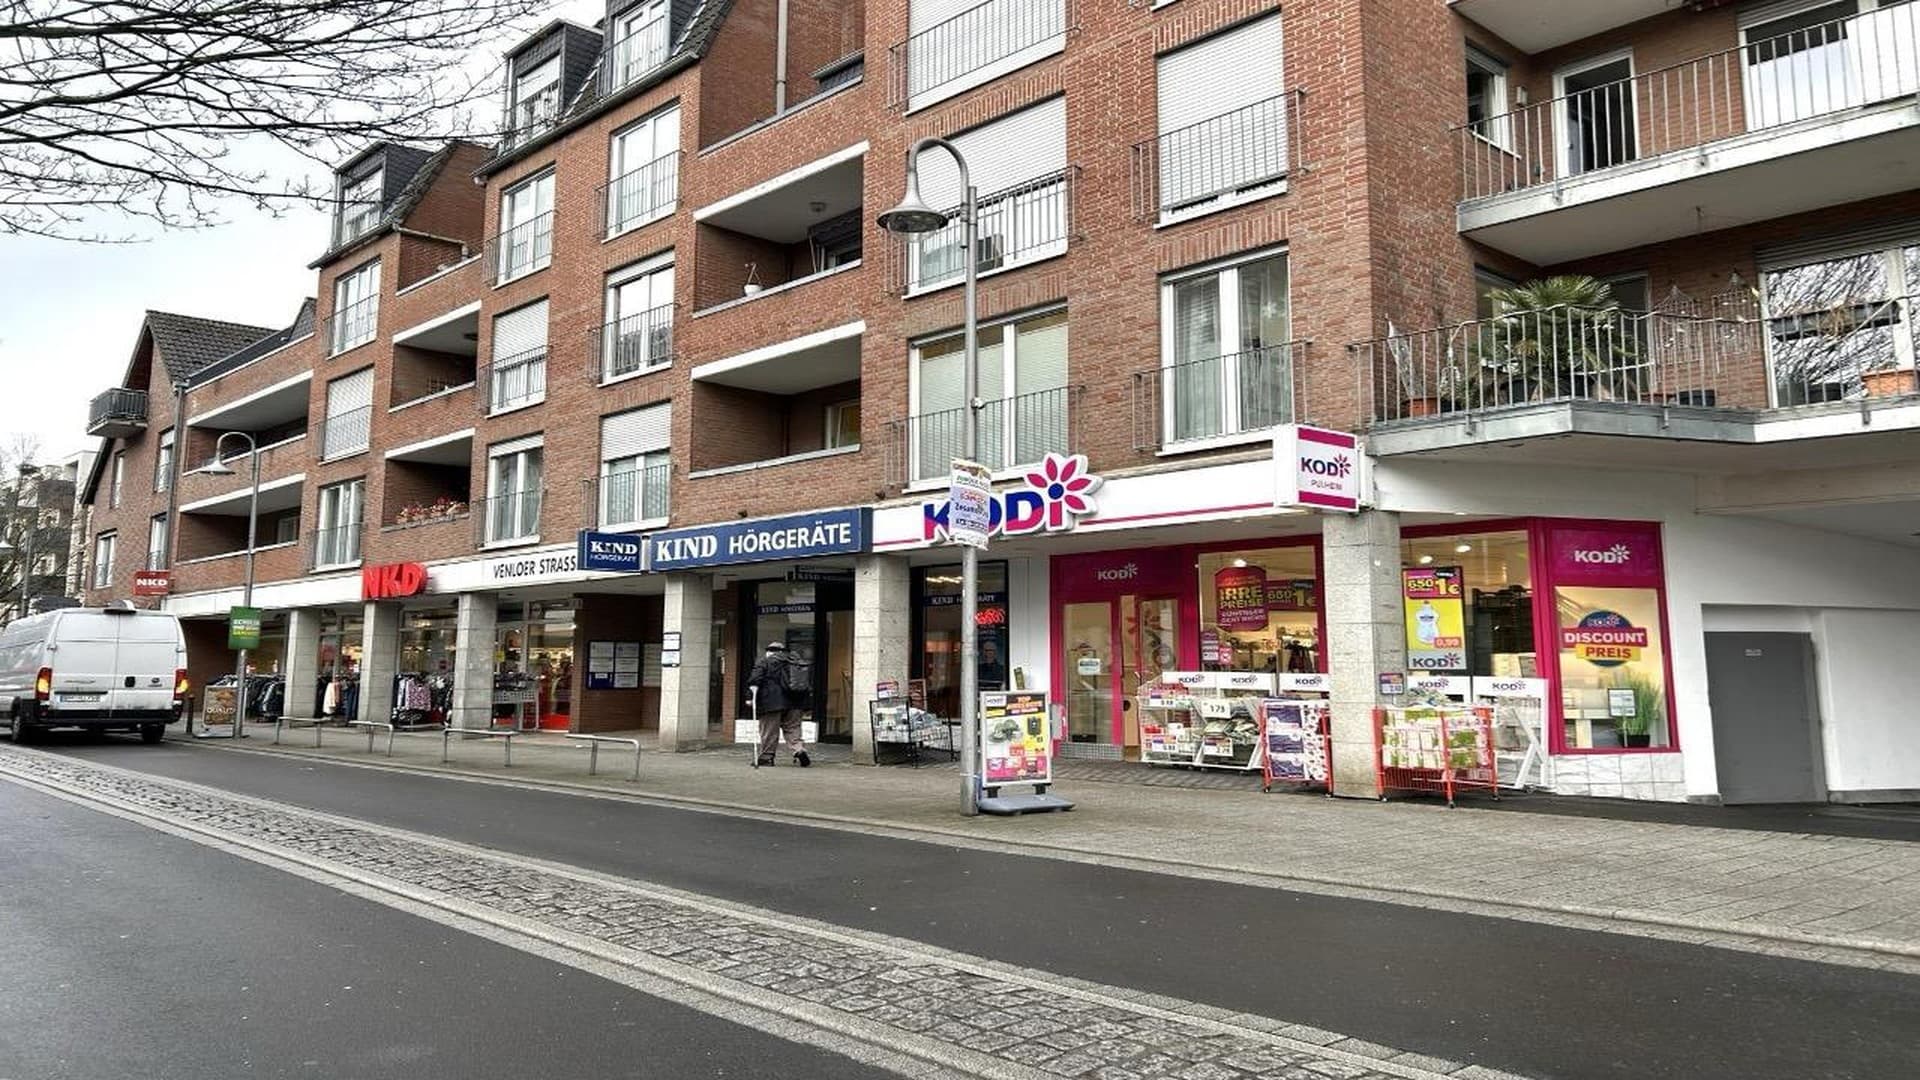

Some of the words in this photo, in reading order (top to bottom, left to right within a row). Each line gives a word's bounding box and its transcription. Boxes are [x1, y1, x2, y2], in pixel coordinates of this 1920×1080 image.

[590, 541, 638, 554] KIND
[656, 535, 717, 562] KIND
[729, 521, 852, 554] HÖRGERÄTE
[493, 560, 535, 578] VENLOER
[136, 578, 168, 586] NKD
[363, 562, 427, 600] NKD
[1219, 586, 1262, 600] IRRE
[1220, 599, 1263, 609] PREISE
[1564, 632, 1644, 643] DISCOUNT
[1586, 647, 1632, 659] PREIS
